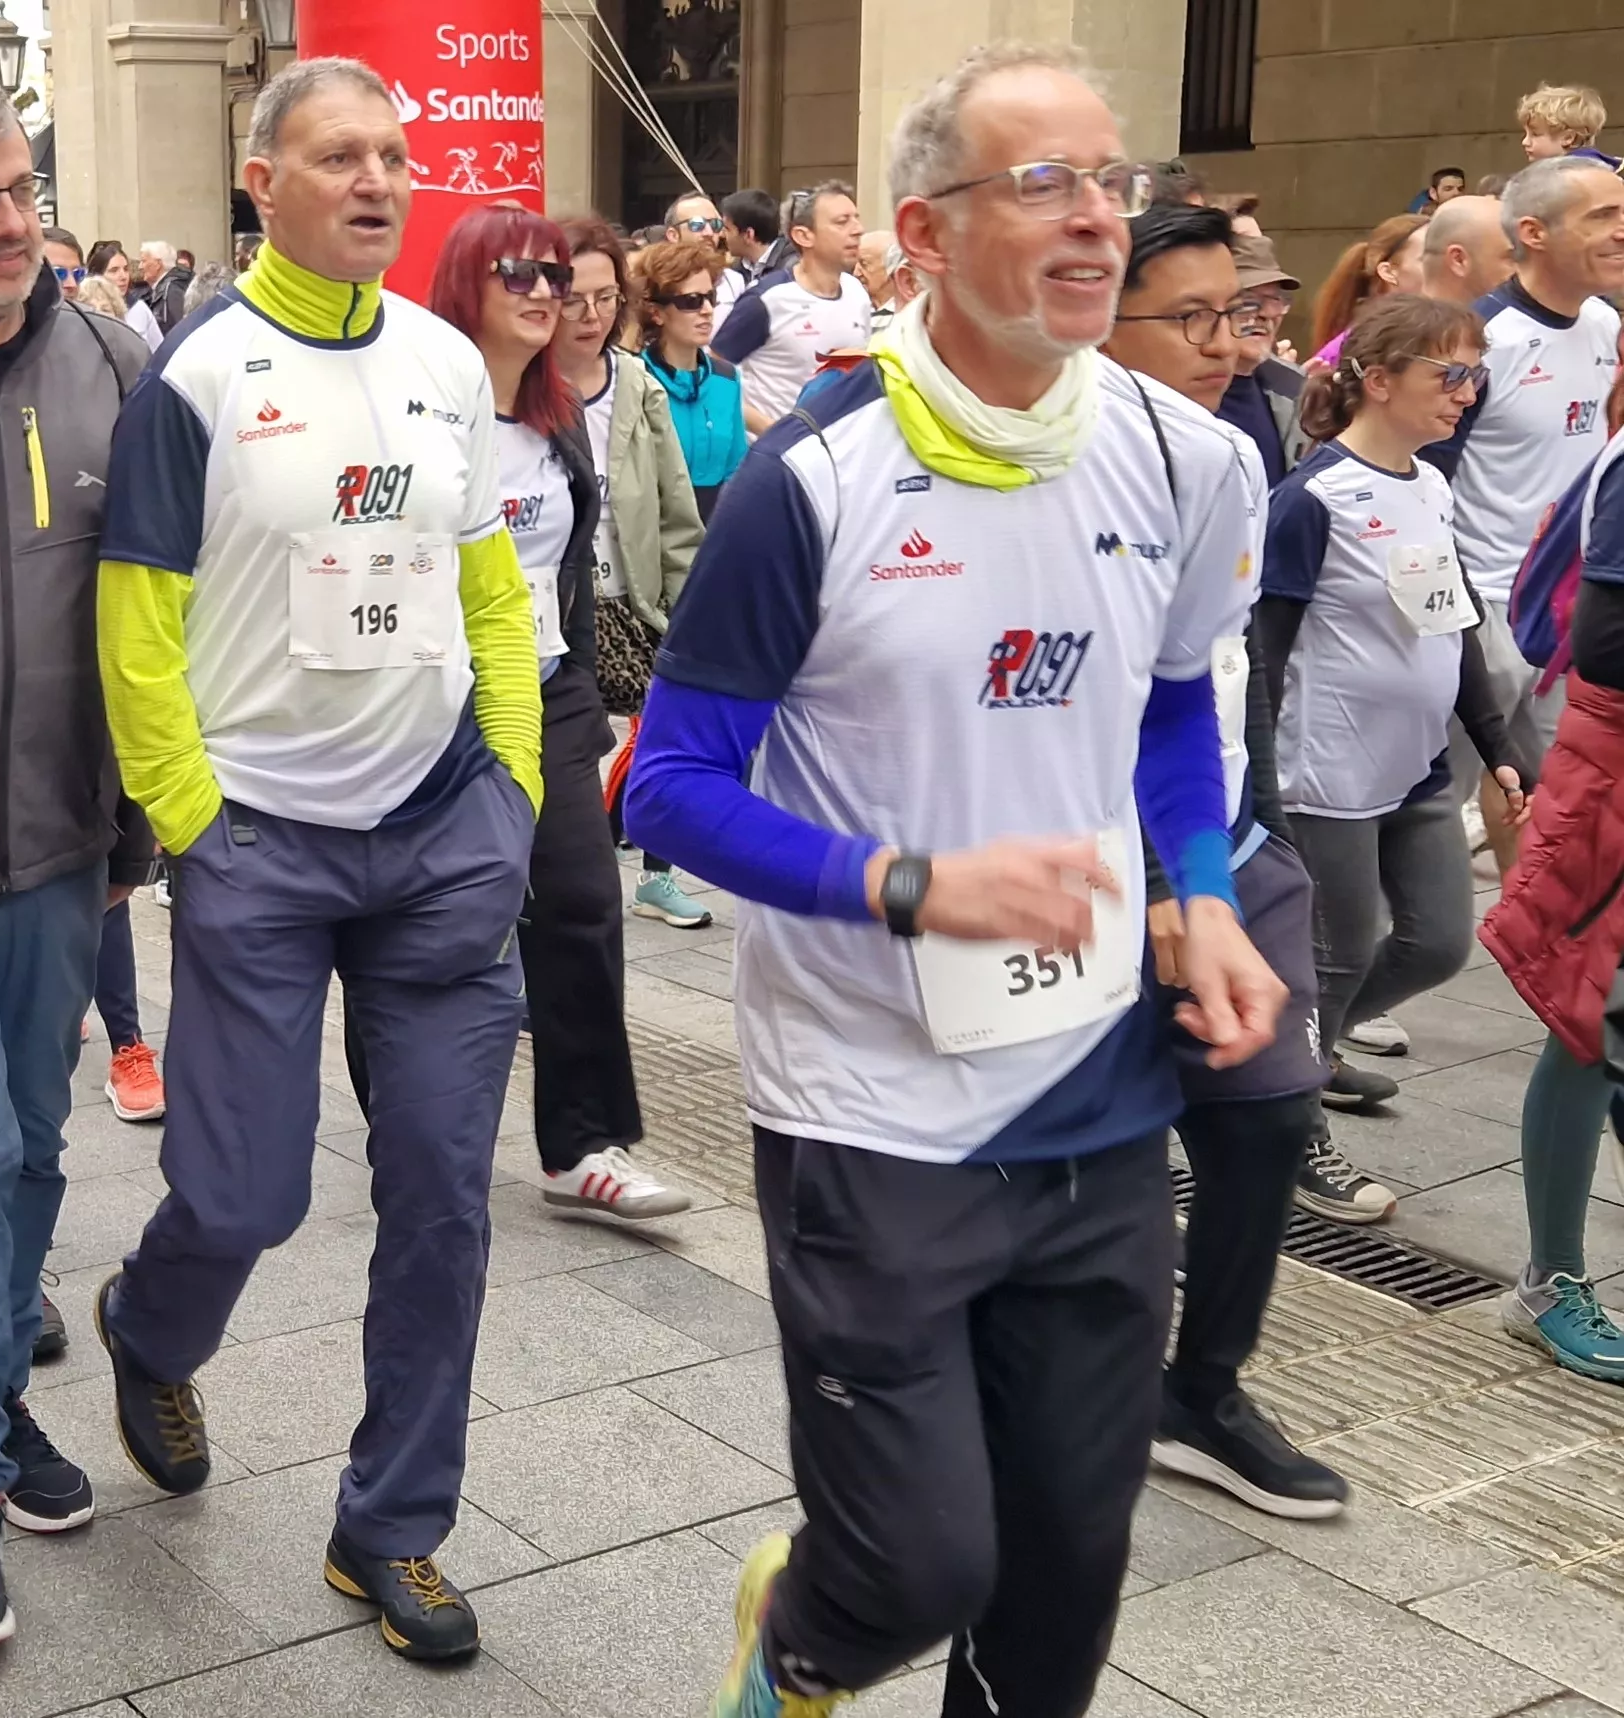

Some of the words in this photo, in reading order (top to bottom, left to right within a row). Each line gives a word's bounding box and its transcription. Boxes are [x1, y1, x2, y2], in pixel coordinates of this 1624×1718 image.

[436, 23, 529, 69] Sports
[236, 420, 309, 444] Santander
[869, 559, 965, 581] Santander
[1424, 588, 1455, 613] 474
[350, 603, 398, 636] 196
[1003, 945, 1085, 996] 351
